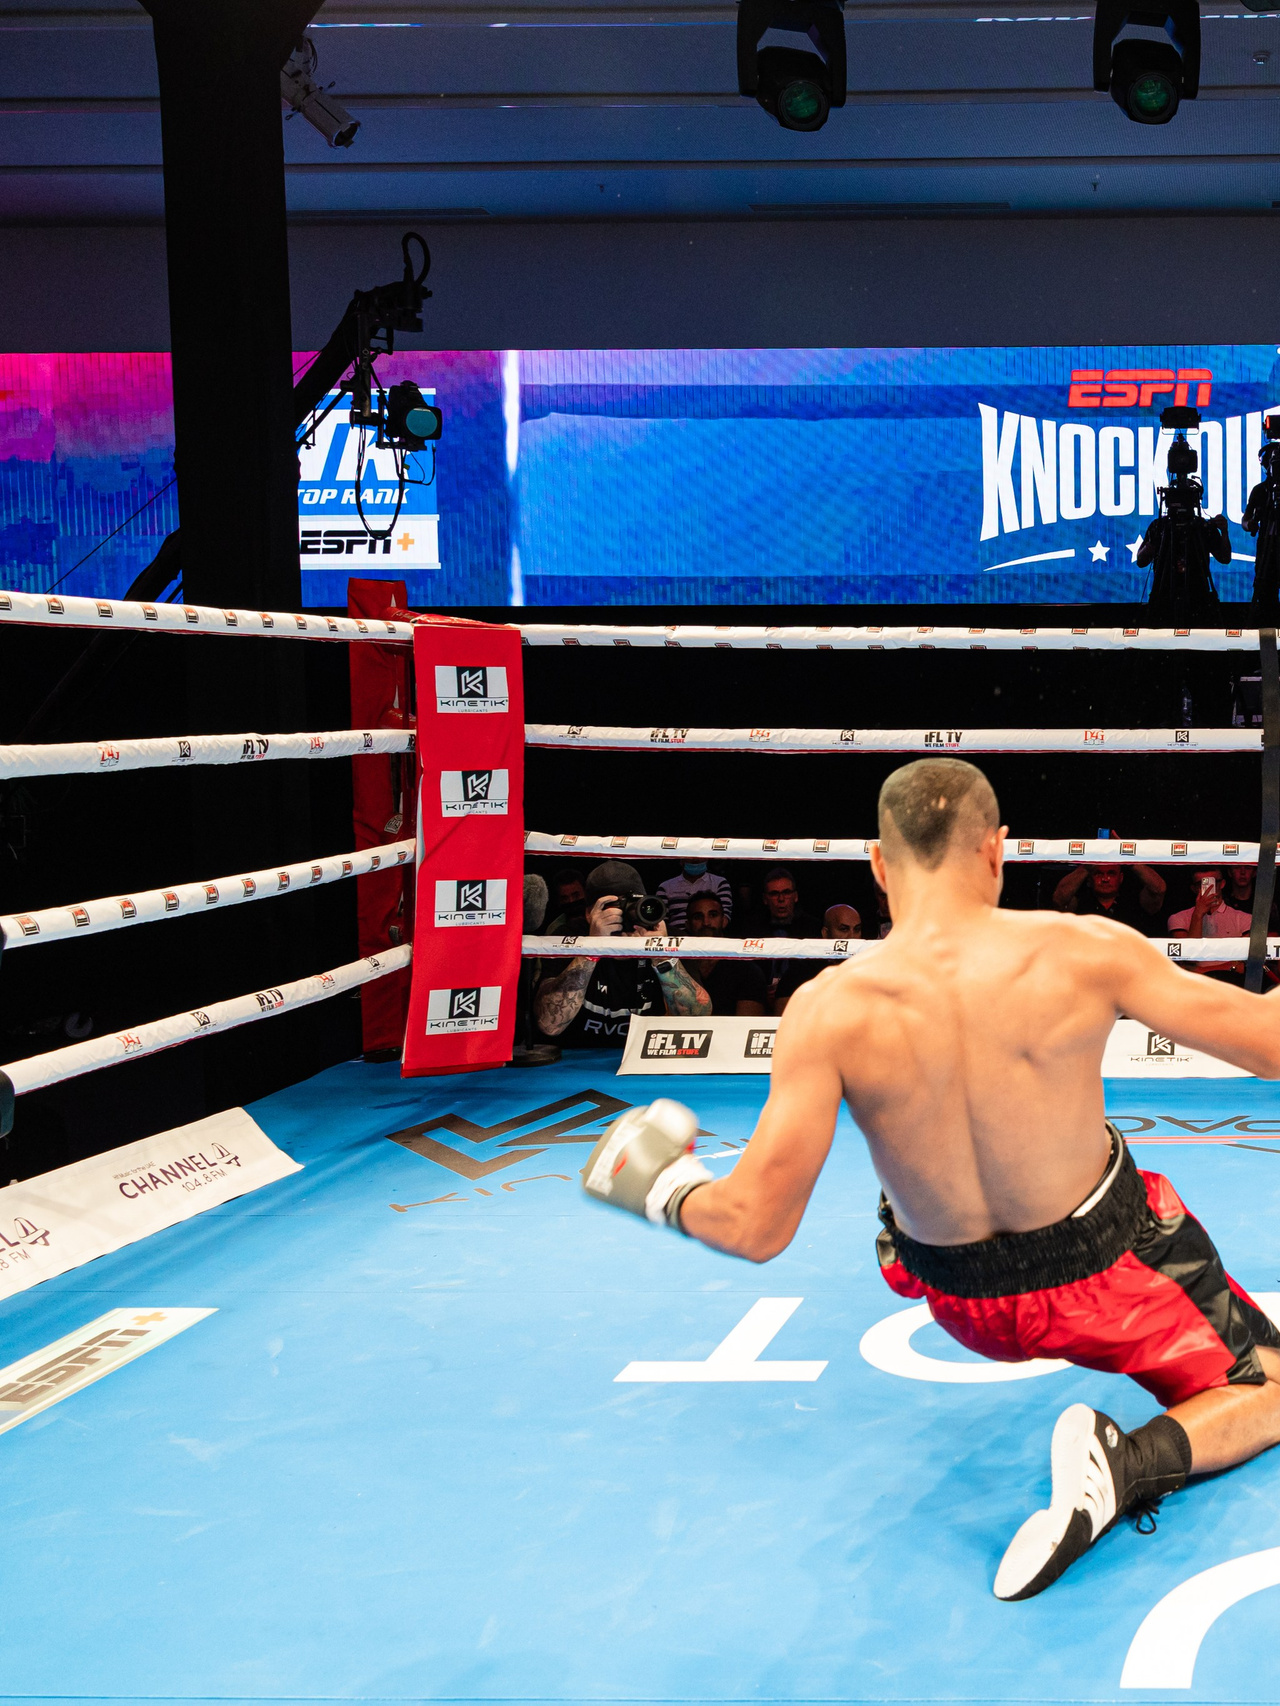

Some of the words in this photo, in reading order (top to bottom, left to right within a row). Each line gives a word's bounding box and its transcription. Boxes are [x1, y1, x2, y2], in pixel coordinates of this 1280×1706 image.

[1068, 369, 1213, 407] ESPN
[441, 698, 507, 707] KINETIK
[924, 732, 943, 742] iFL
[946, 732, 963, 742] TV
[446, 802, 507, 810] KINETIK
[438, 912, 504, 920] KINETIK
[430, 1018, 496, 1028] KINETIK
[648, 1034, 676, 1049] iFL
[681, 1033, 707, 1049] TV
[119, 1152, 218, 1199] CHANNEL
[210, 1169, 228, 1180] FM
[9, 1249, 31, 1264] FM
